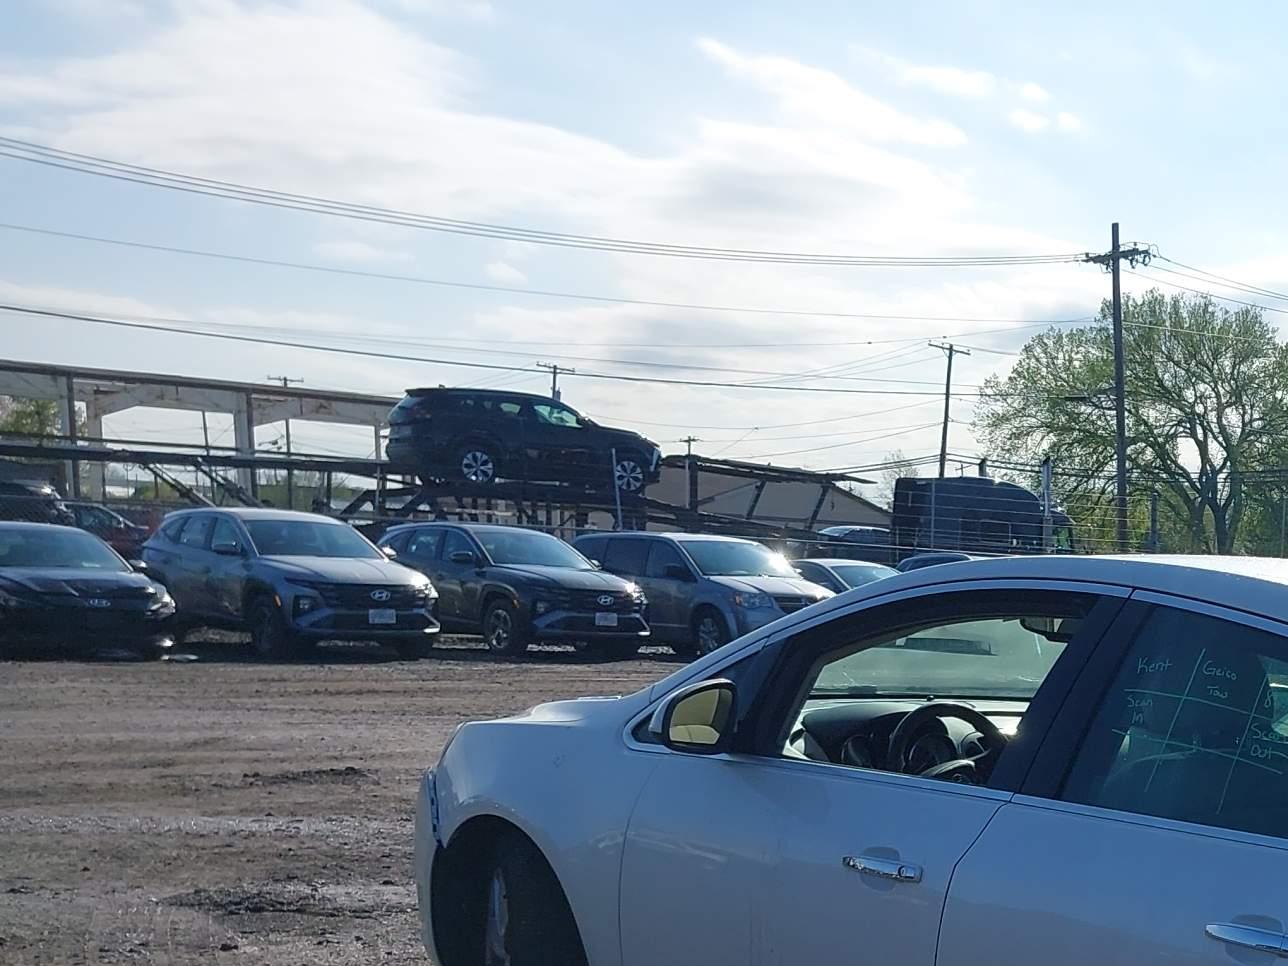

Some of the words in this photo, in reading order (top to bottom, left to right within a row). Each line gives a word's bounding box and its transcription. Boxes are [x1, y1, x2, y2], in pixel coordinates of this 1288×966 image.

[1137, 657, 1173, 674] Kent
[1202, 660, 1238, 680] Geico
[1207, 685, 1229, 699] Tow
